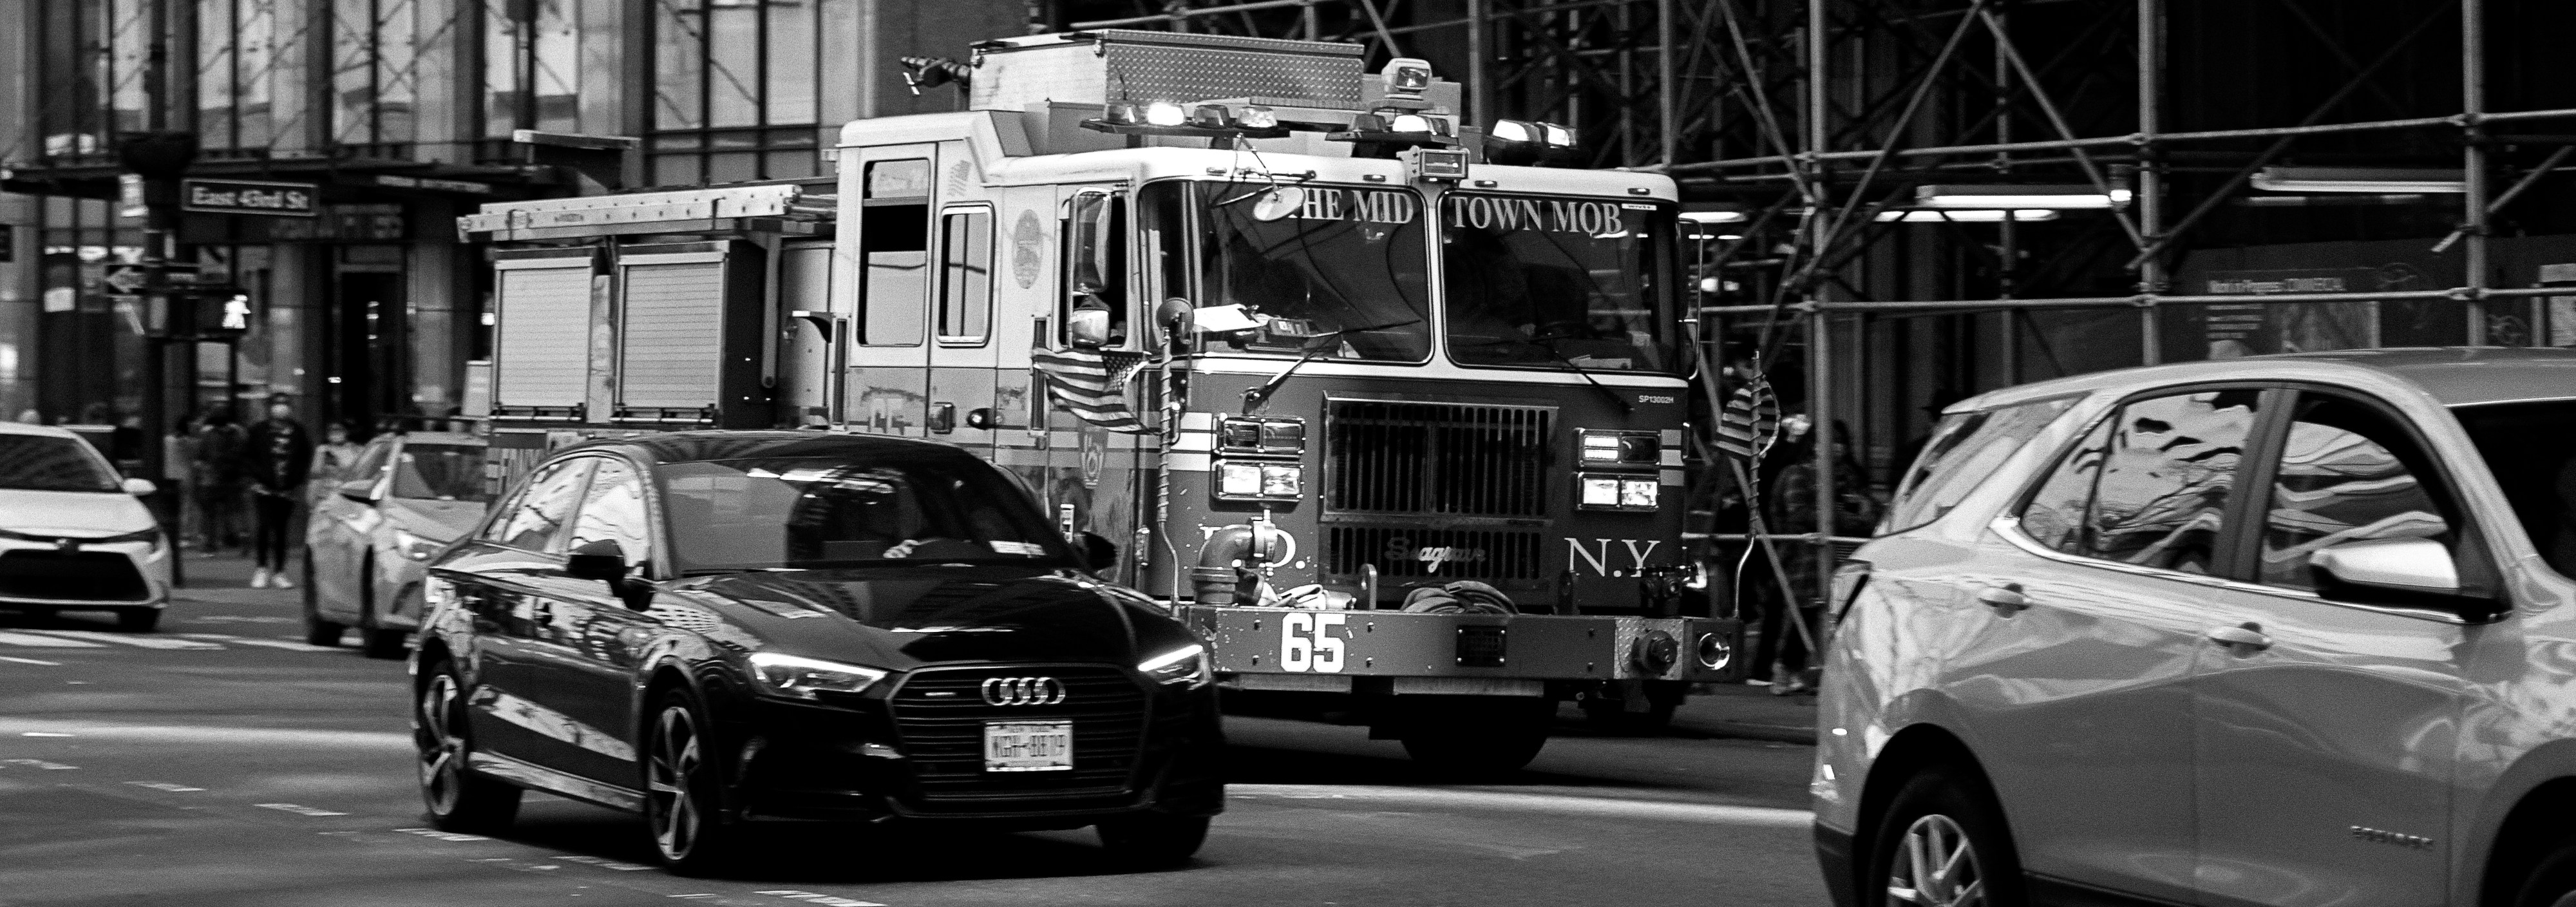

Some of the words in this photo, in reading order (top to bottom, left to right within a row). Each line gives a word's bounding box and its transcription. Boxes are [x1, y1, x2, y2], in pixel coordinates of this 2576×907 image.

[193, 186, 236, 205] East
[286, 191, 308, 209] St
[1288, 187, 1345, 220] HE
[1351, 190, 1414, 224] MID
[1449, 196, 1542, 231] TOWN
[1280, 612, 1346, 674] 65
